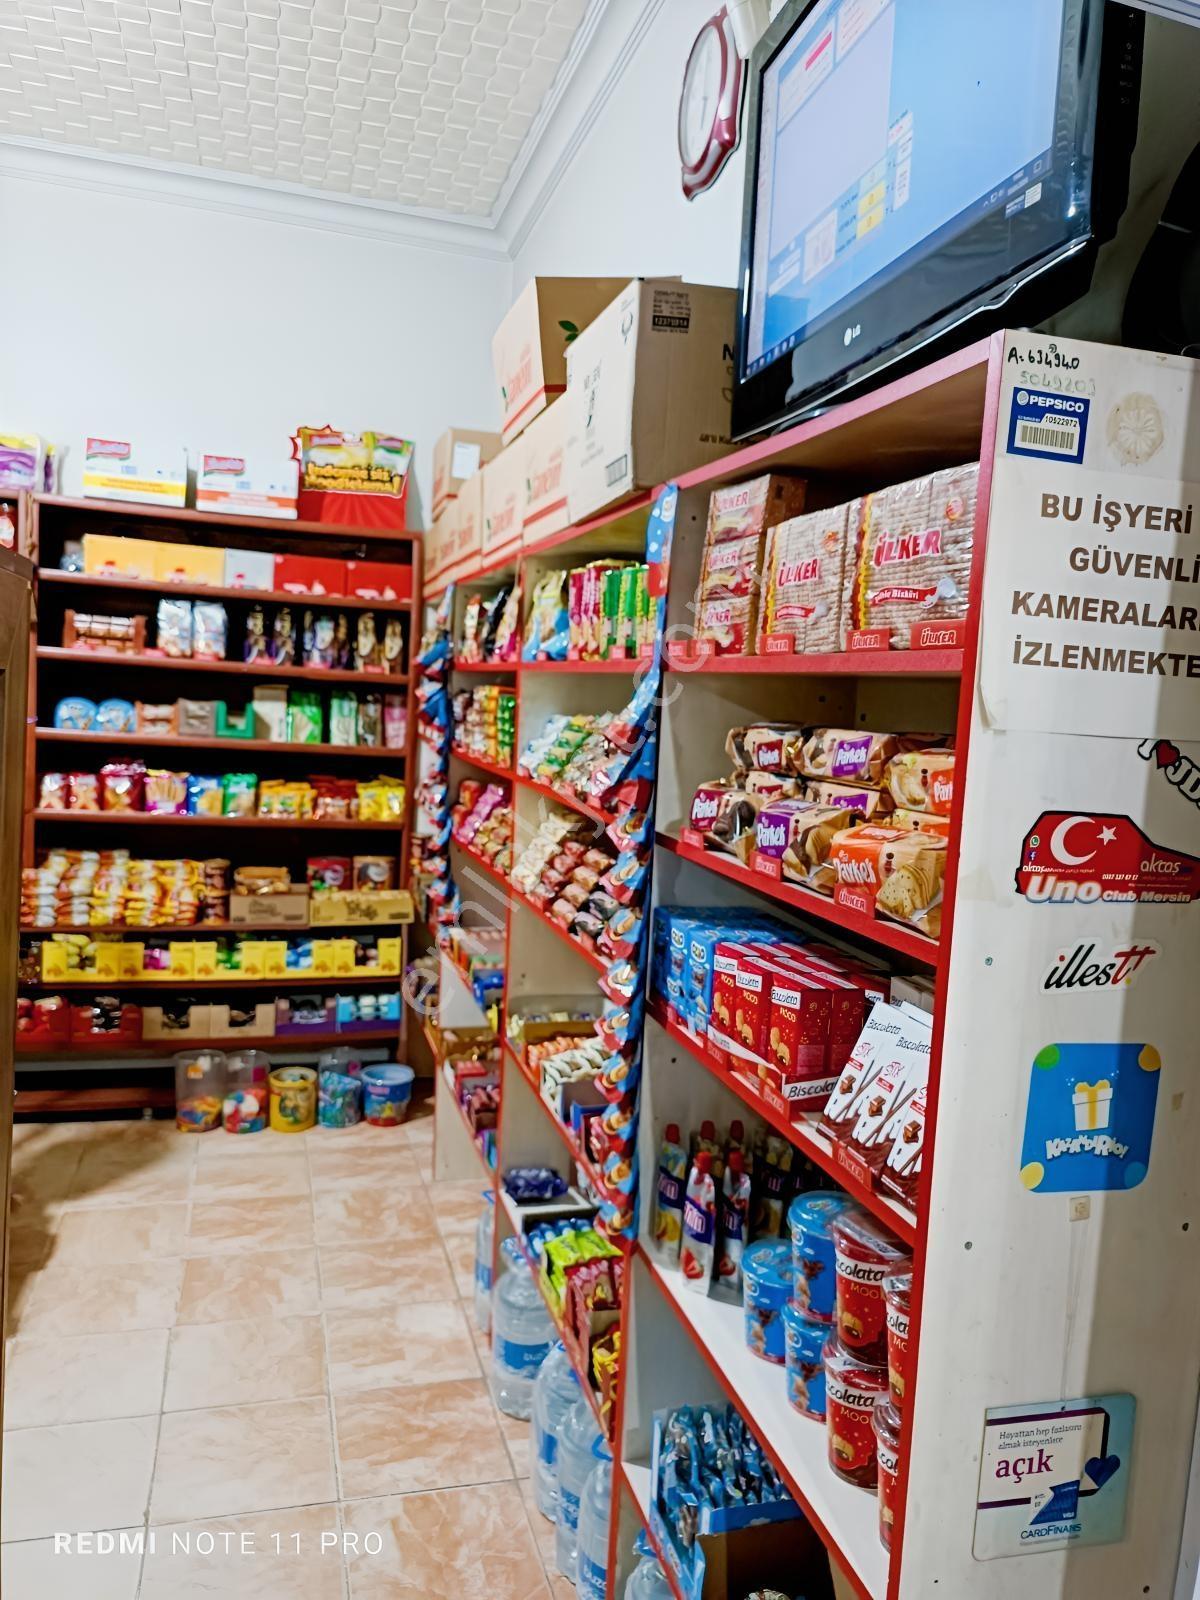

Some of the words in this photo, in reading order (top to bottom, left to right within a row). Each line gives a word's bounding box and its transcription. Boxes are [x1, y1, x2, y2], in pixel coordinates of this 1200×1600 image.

[1029, 395, 1085, 413] PEPSICO
[1040, 493, 1083, 522] BU
[1092, 493, 1193, 534] İŞYERİ
[873, 528, 942, 569] ÜLKER
[778, 557, 822, 588] ÜLKER
[851, 632, 880, 649] ÜLKER
[920, 627, 957, 648] ÜLKER
[839, 888, 866, 913] ÜLKER
[1026, 874, 1102, 903] Uno
[1103, 889, 1138, 903] Club
[1139, 890, 1192, 903] Mersin
[867, 1018, 902, 1036] Biscolata
[995, 1448, 1054, 1484] açık
